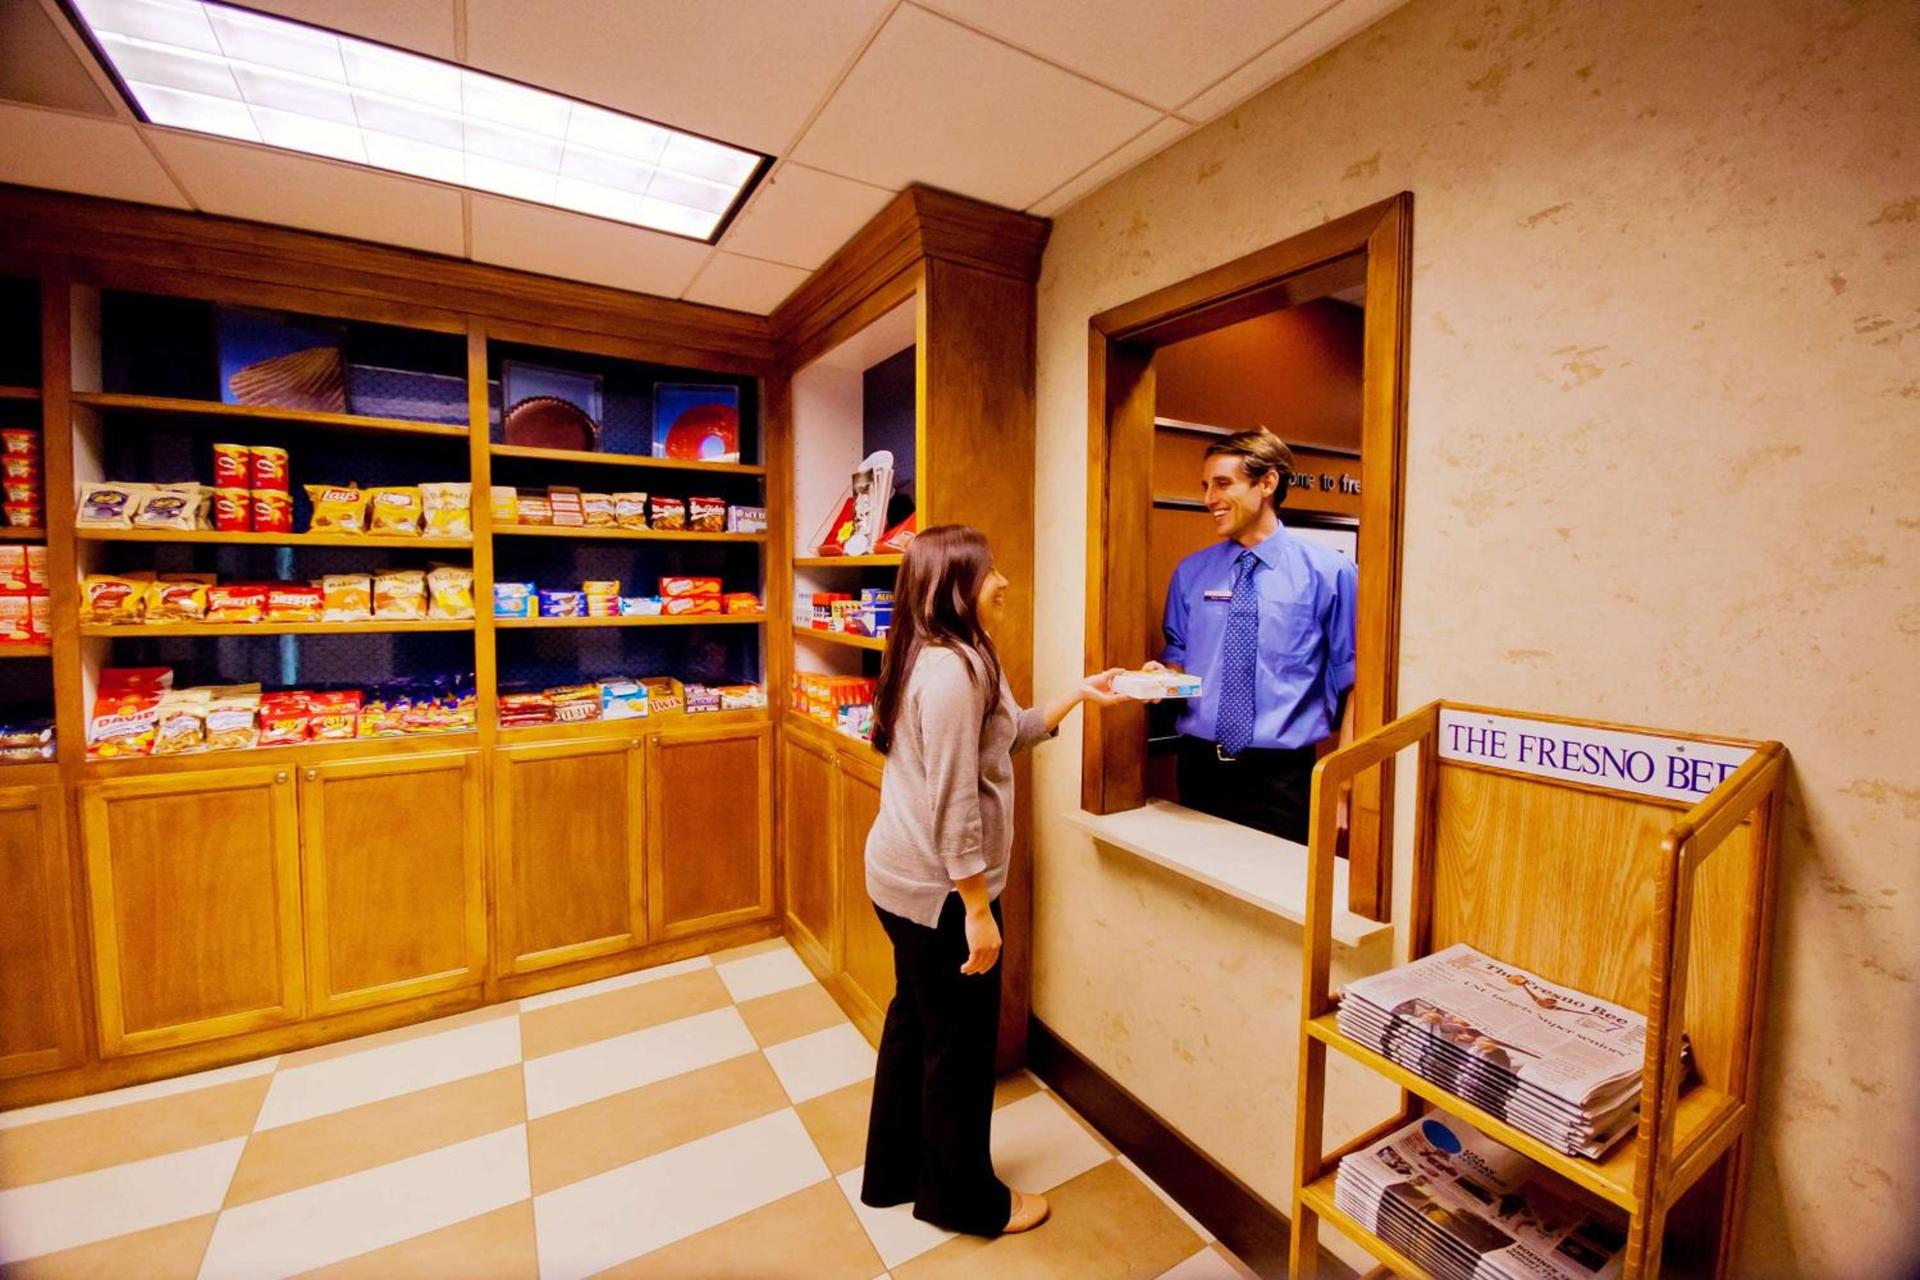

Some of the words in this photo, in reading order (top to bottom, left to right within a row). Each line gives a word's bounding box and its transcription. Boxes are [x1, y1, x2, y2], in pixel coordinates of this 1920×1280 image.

[1321, 472, 1336, 491] to
[98, 710, 155, 728] DAVID
[1448, 723, 1507, 760] THE
[1517, 733, 1654, 783] FRESNO
[1526, 979, 1586, 1009] Fresno
[1591, 1006, 1628, 1025] Bee
